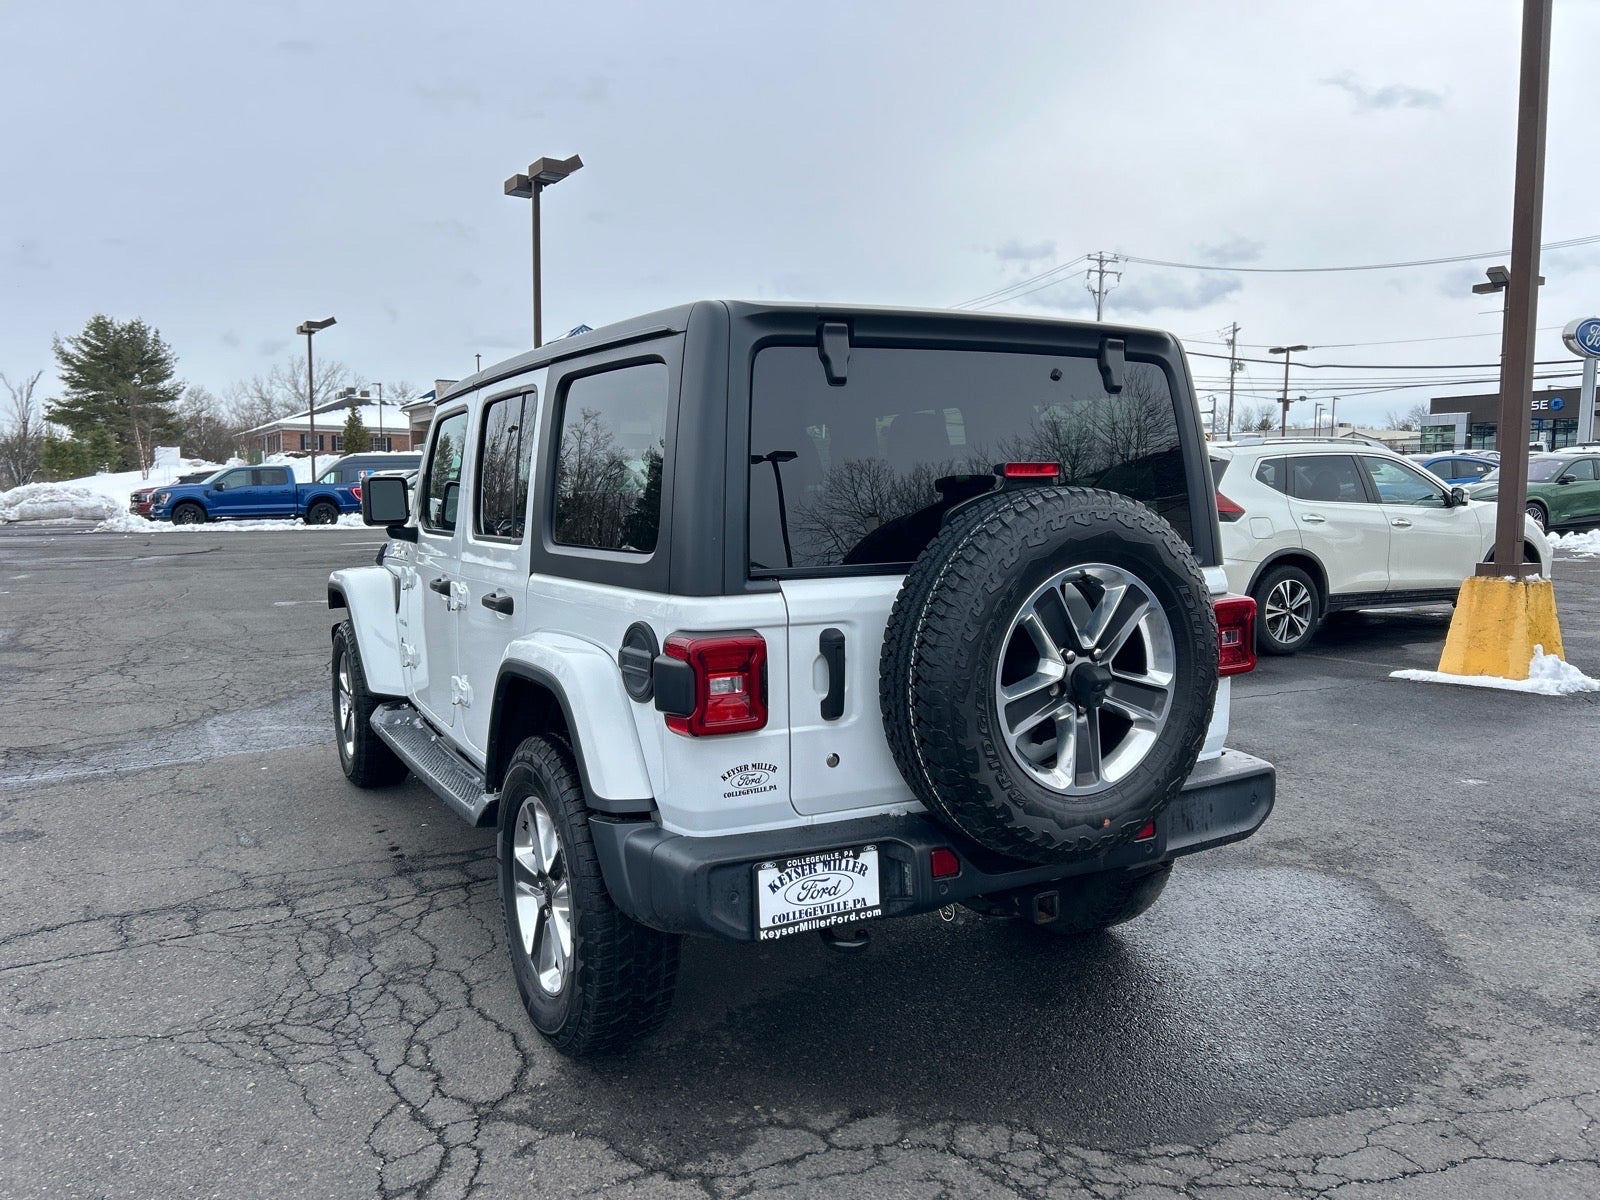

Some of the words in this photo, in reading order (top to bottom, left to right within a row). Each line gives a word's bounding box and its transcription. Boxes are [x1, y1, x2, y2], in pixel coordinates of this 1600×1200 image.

[1586, 324, 1600, 347] Fo
[721, 764, 749, 781] KEYSER
[751, 763, 778, 773] MILLER
[737, 773, 763, 786] Ford
[787, 852, 842, 867] COLLEGEVILLE,
[844, 850, 854, 858] PA
[767, 863, 818, 895] KEYSER
[822, 859, 869, 877] MILLER
[797, 877, 842, 902] Ford
[760, 908, 882, 940] KeyserMillerFord.com
